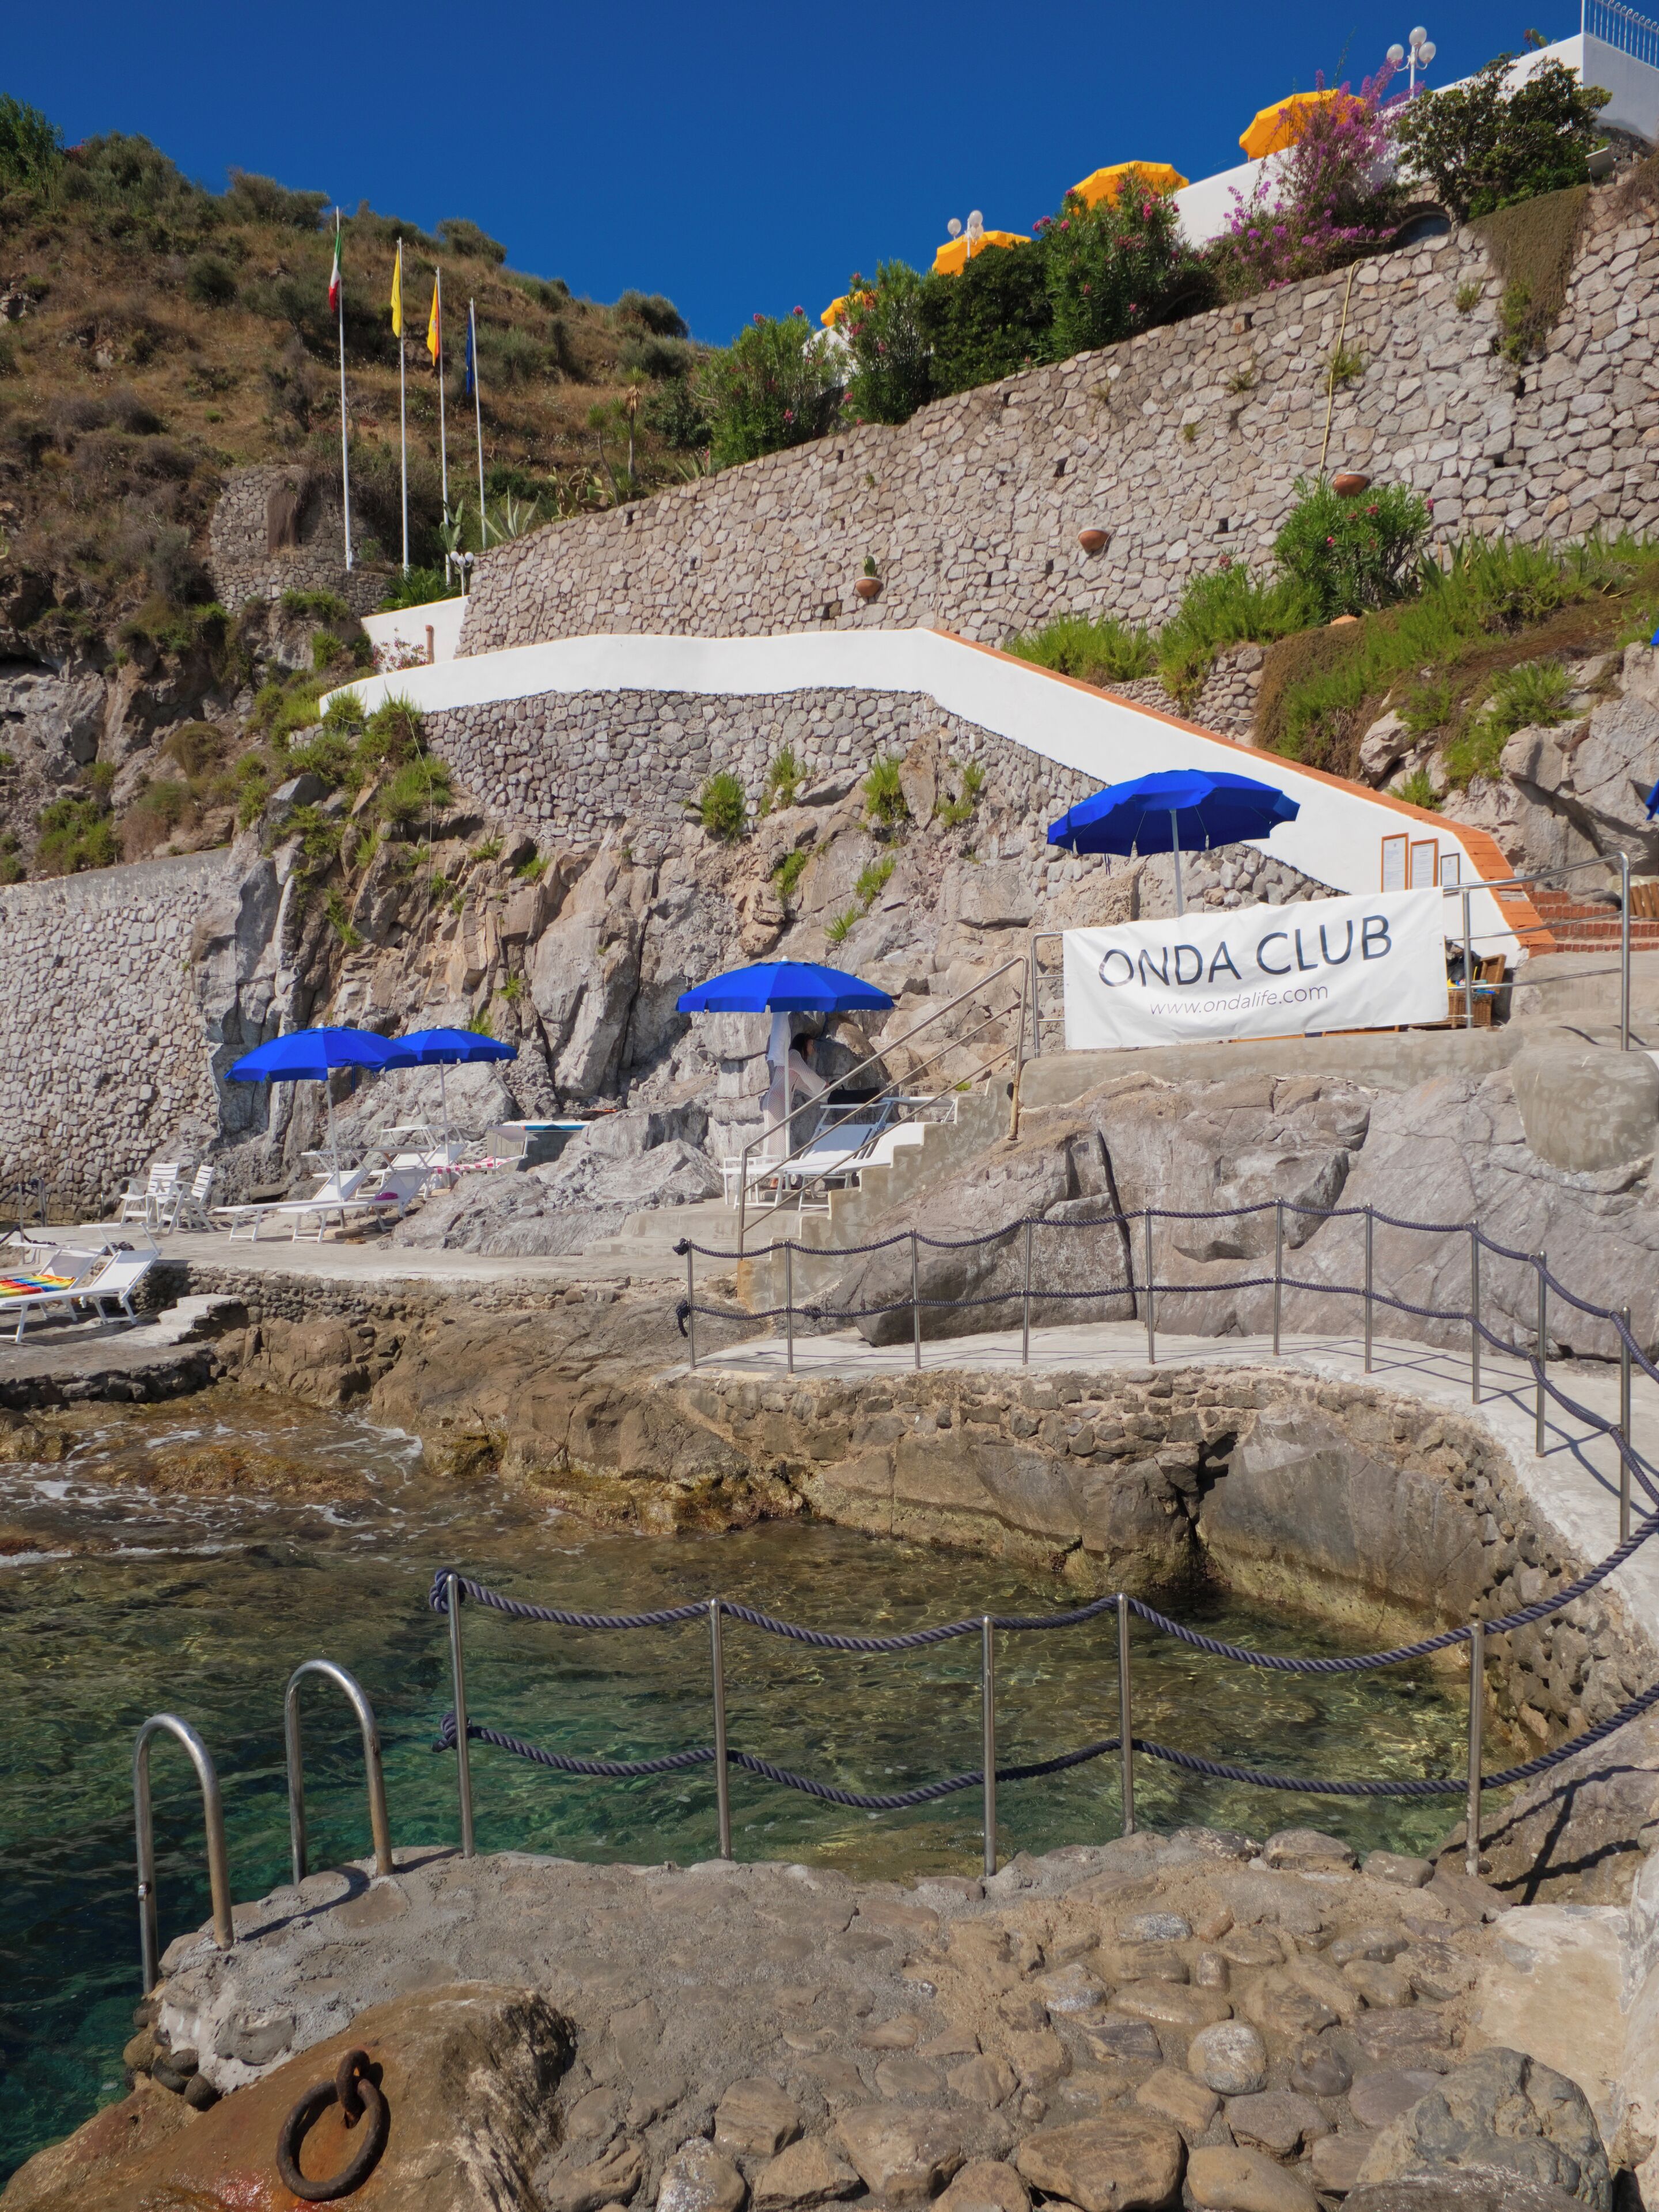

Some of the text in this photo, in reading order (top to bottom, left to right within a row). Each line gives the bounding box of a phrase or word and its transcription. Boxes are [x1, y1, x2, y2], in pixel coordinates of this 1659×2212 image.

[1099, 915, 1392, 987] ONDA CLUB
[1150, 984, 1328, 1015] www.ondalife.com
